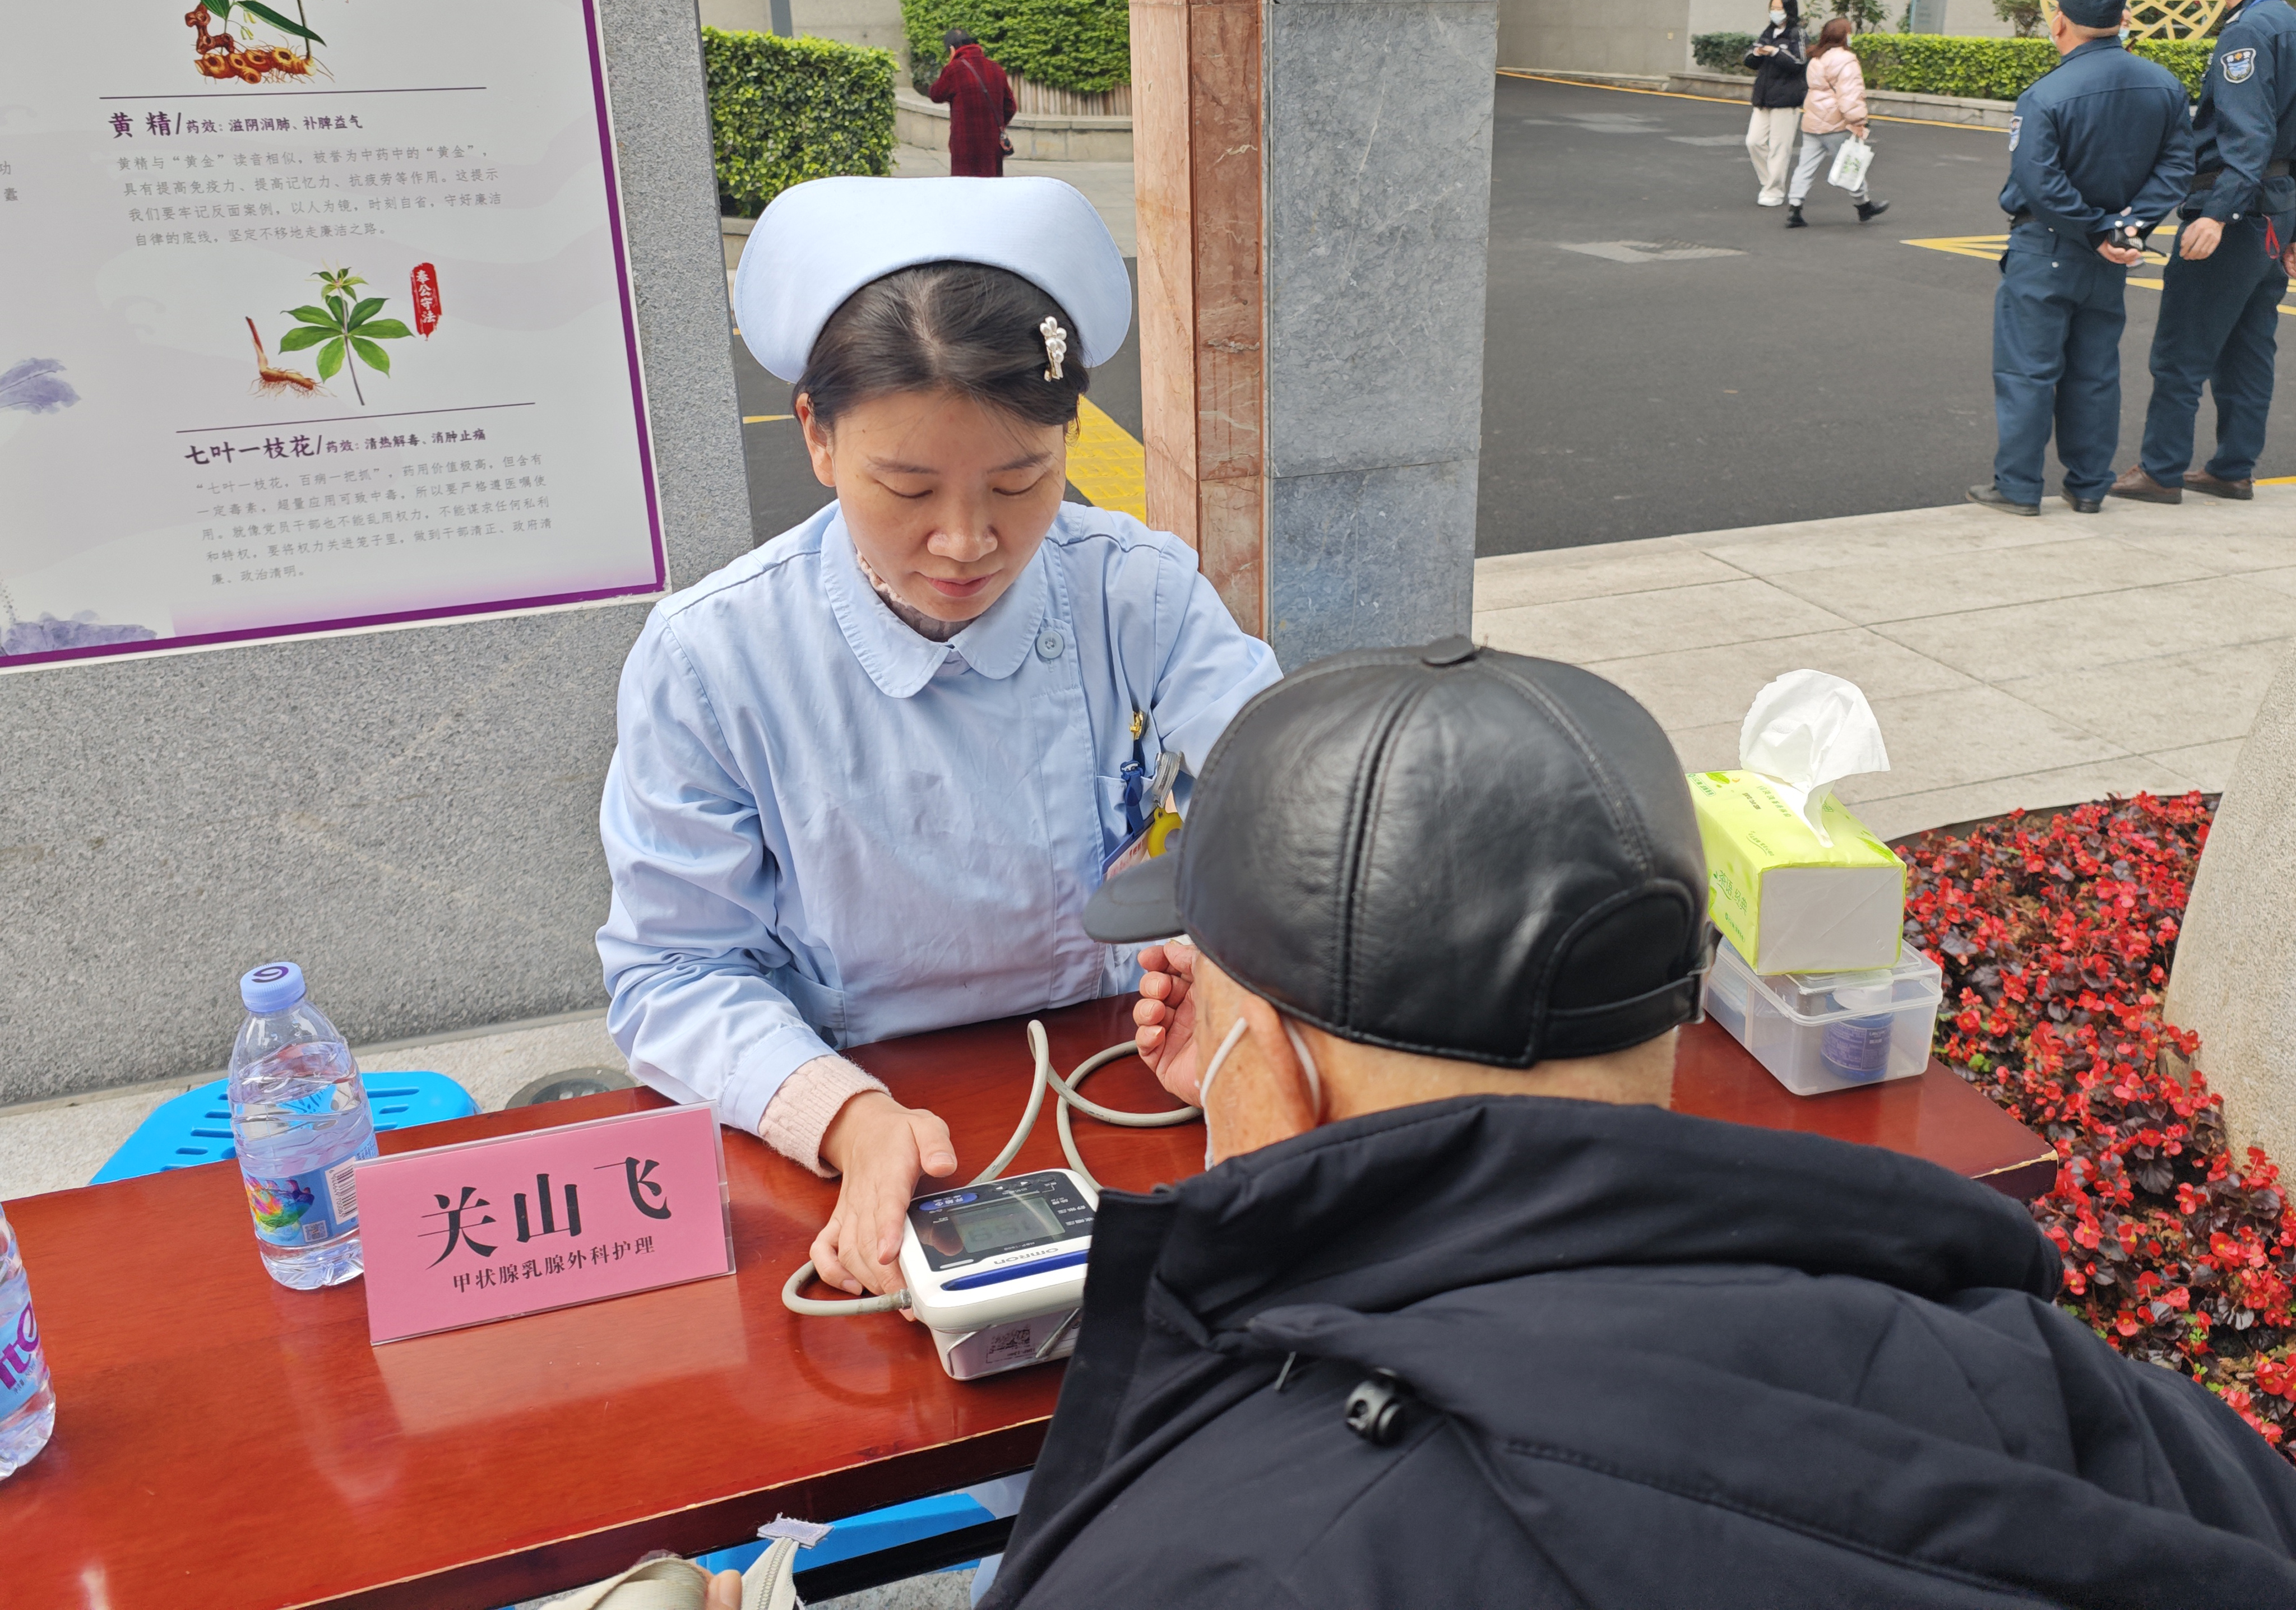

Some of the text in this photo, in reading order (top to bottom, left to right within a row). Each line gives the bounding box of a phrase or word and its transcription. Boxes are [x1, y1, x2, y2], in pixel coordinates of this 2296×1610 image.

[416, 269, 437, 323] 奉公守法
[417, 1156, 672, 1270] 关山飞
[453, 1235, 656, 1293] 甲状腺乳腺外科护理
